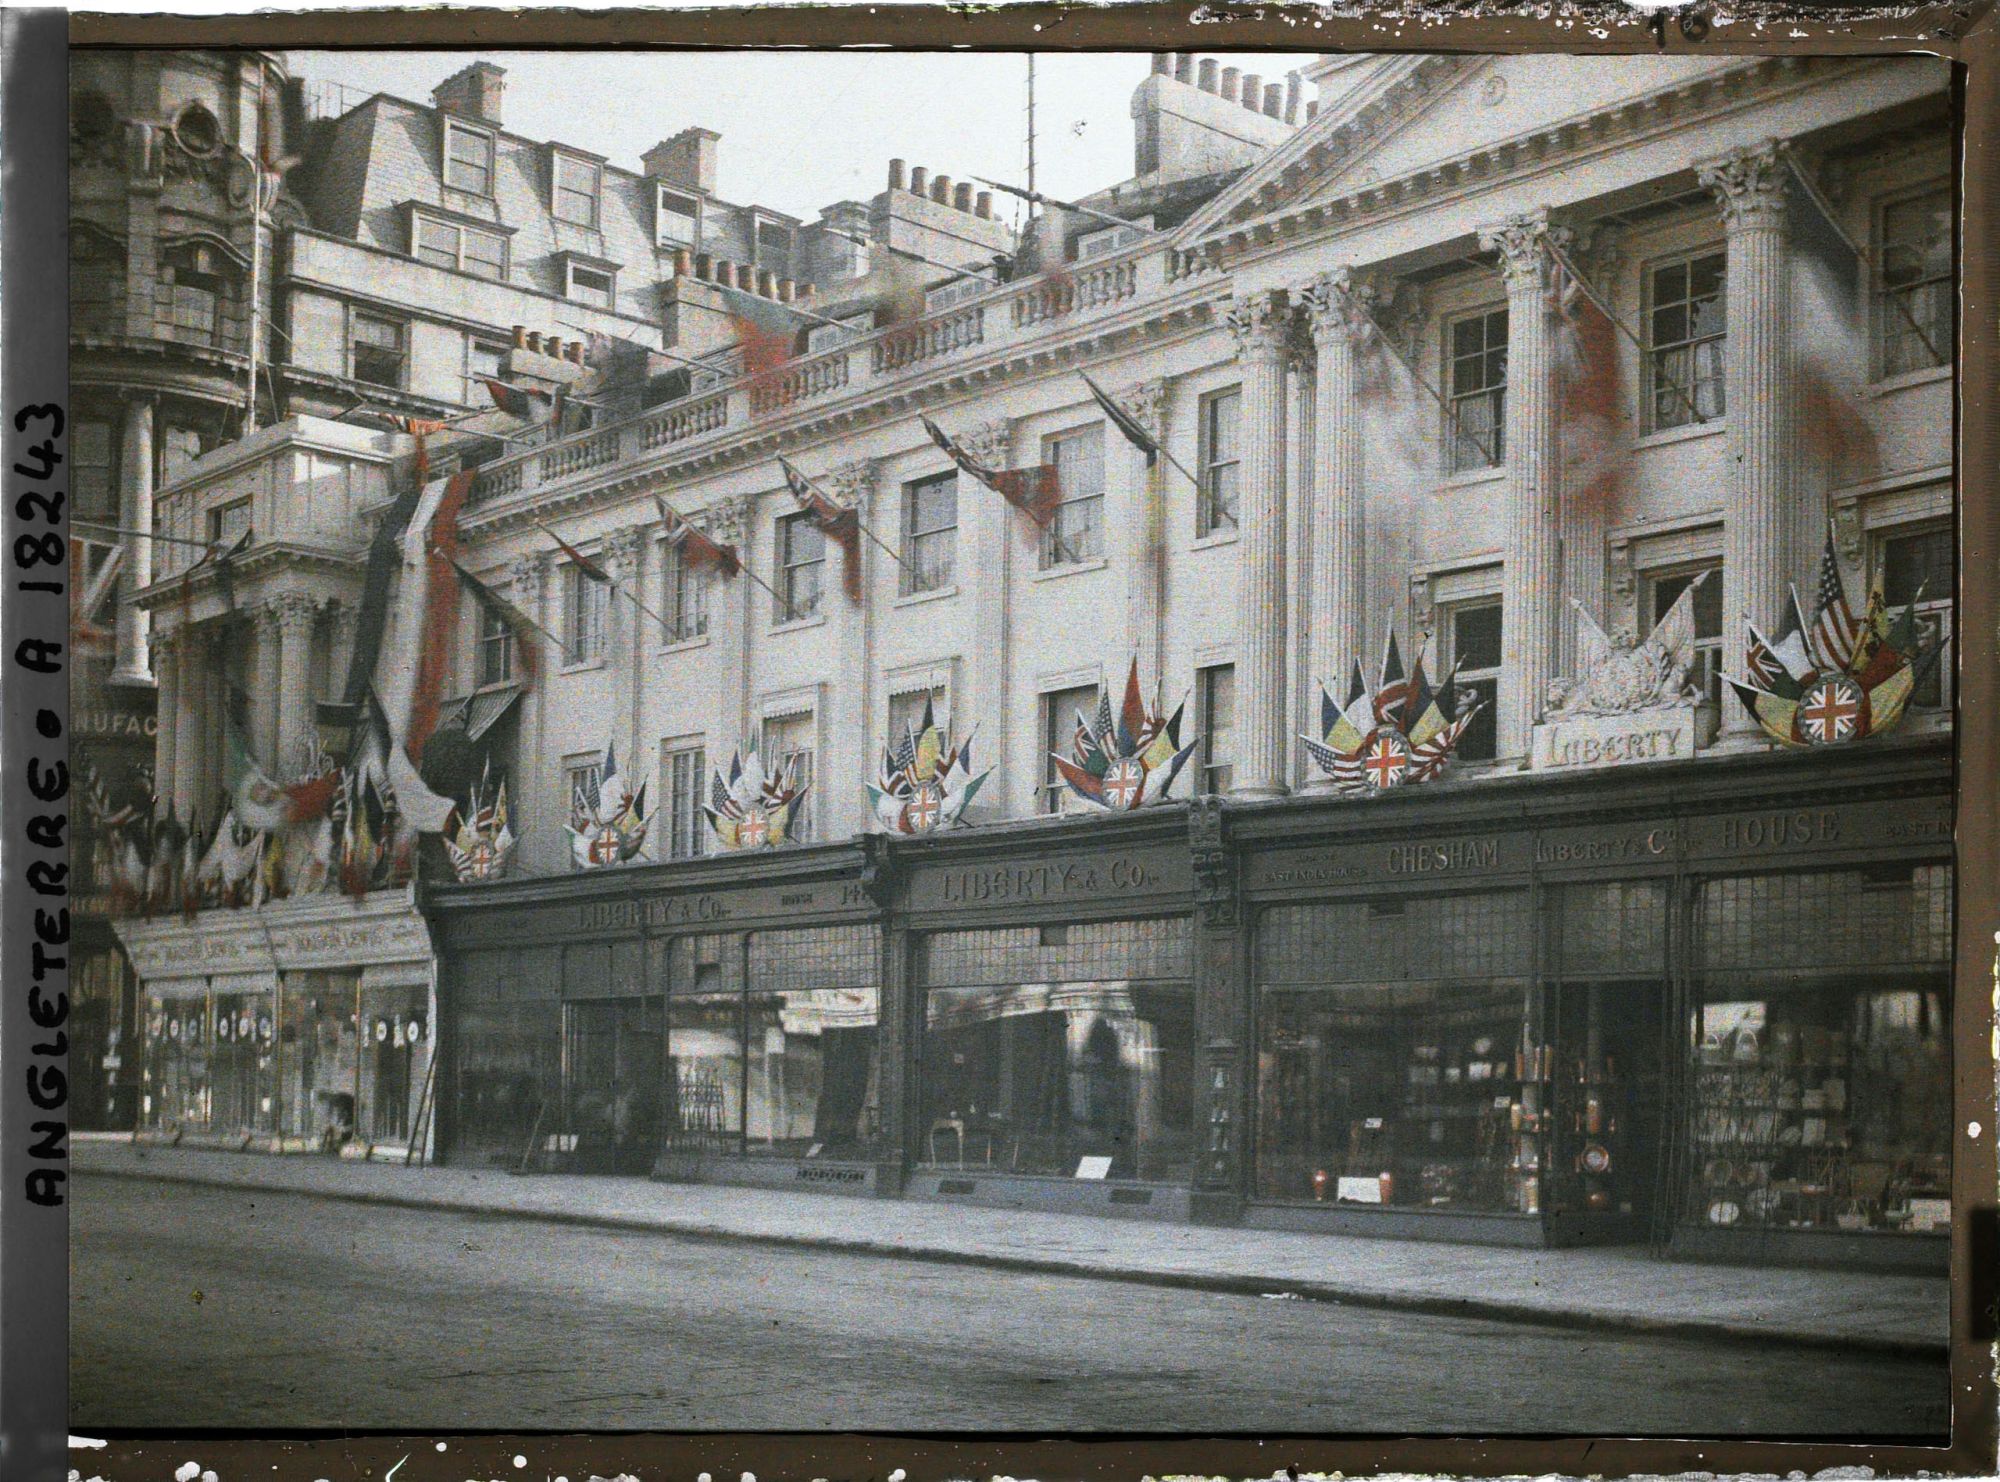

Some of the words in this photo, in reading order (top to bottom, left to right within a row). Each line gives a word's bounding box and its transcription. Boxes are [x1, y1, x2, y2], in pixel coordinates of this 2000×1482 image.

[13, 401, 67, 597] 18243
[13, 638, 64, 675] A
[1544, 726, 1682, 768] LIBERTY
[1388, 839, 1498, 875] CHESHAM
[1720, 811, 1841, 850] HOUSE
[1535, 837, 1631, 863] LIBERTY
[944, 863, 1075, 903] LIBERTY
[579, 896, 674, 932] LIBERTY
[24, 756, 67, 1208] ANGLETERRE
